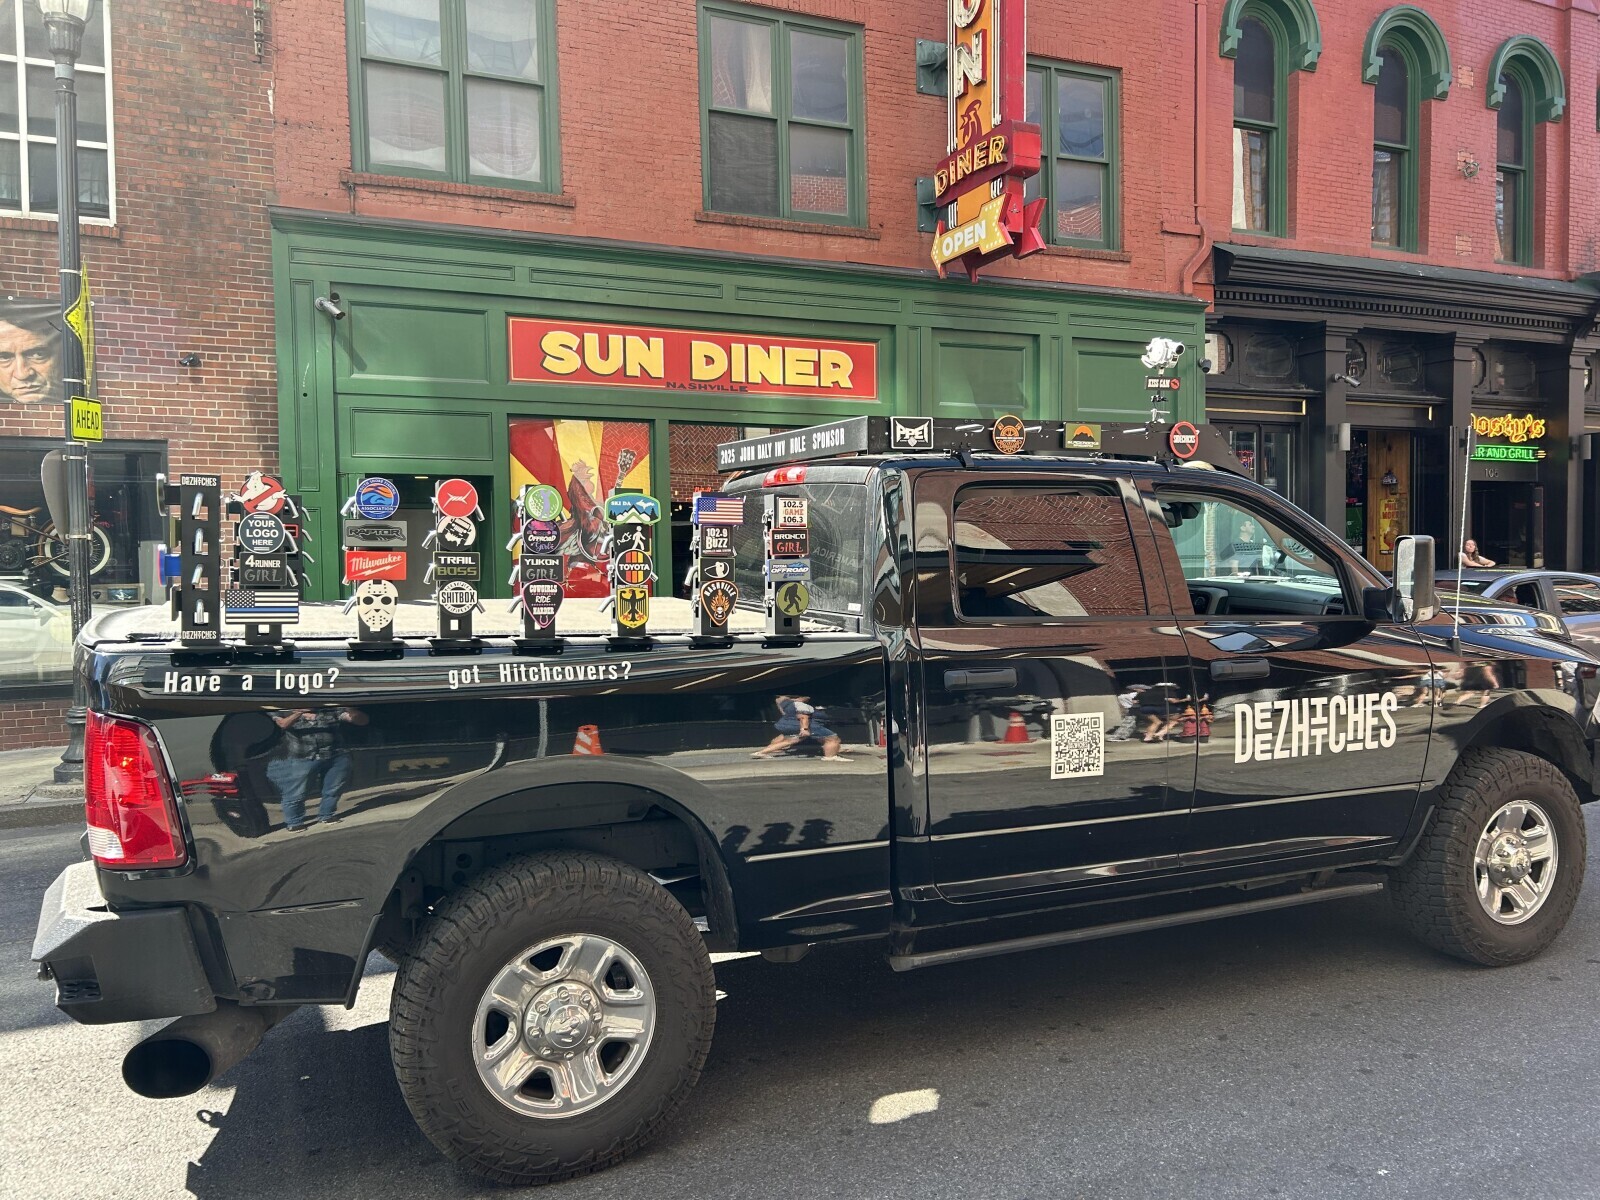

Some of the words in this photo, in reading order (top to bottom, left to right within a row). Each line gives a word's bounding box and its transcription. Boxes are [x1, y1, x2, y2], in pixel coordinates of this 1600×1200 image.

[934, 135, 1005, 198] DINER
[942, 219, 986, 257] OPEN
[540, 330, 665, 378] SUN
[690, 340, 854, 388] DINER
[666, 381, 749, 393] NASHVILLE
[75, 408, 100, 430] AHEAD
[720, 448, 735, 464] 2025
[740, 444, 756, 462] JOHN
[757, 442, 772, 460] DALY
[789, 435, 806, 454] HOLE
[812, 427, 845, 450] SPONSOR
[1487, 448, 1506, 459] AND
[1508, 449, 1535, 460] GRILL
[247, 520, 276, 528] YOUR
[783, 516, 804, 524] 106.3
[246, 529, 279, 538] LOGO
[349, 528, 400, 537] RAPTOR
[706, 528, 728, 538] 102.9
[776, 542, 804, 553] GIRL
[245, 555, 281, 568] 4RUNNER
[350, 554, 404, 572] Milwaukee
[438, 556, 476, 565] TRAIL
[437, 567, 478, 576] BOSS
[619, 563, 650, 571] TOYOTA
[244, 569, 282, 582] GIRL
[526, 568, 559, 580] GIRL
[703, 582, 736, 597] NASHVILLE
[441, 591, 476, 603] SHITBOX
[535, 595, 552, 603] RIDE
[164, 671, 221, 693] Have
[242, 674, 253, 691] a
[275, 667, 340, 695] logo?
[448, 665, 481, 690] got
[499, 660, 632, 683] Hitchcovers?
